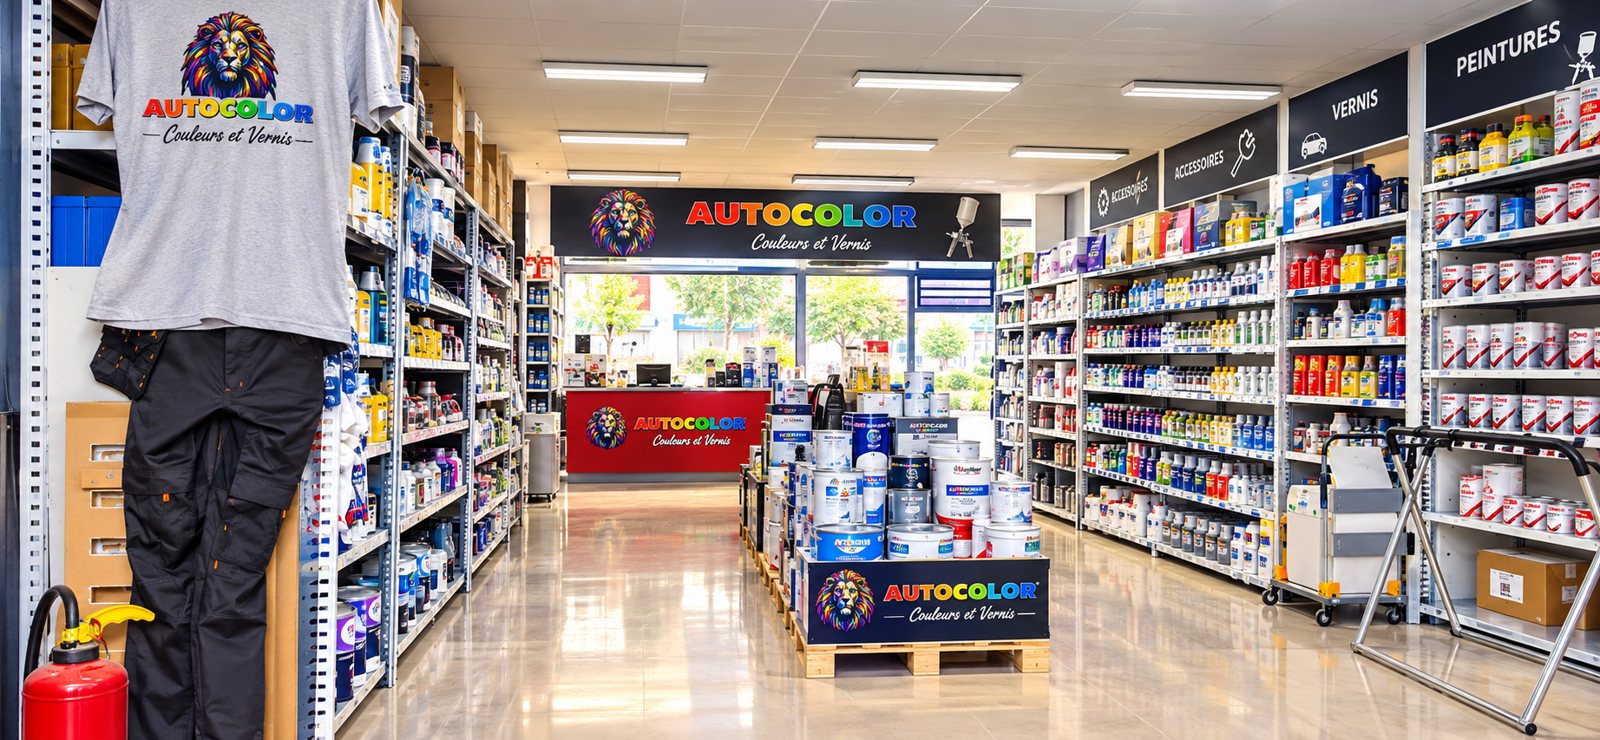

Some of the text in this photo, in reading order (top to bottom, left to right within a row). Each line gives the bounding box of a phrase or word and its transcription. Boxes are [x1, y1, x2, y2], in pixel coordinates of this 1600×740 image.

[1456, 20, 1561, 78] PEINTURES
[142, 98, 314, 124] AUTOCOLOR
[1331, 88, 1379, 120] VERNIS
[163, 124, 293, 145] Couleurs et Vernis
[1174, 149, 1224, 180] ACCESSOIRES
[685, 201, 917, 228] AUTOCOLOR
[751, 233, 872, 252] Couleurs et Vernis
[633, 416, 746, 431] AUTOCOLOR
[652, 434, 691, 447] Couleurs
[692, 436, 703, 446] et
[883, 582, 1038, 602] AUTOCOLOR
[909, 605, 1015, 623] Couleurs et Vernis
